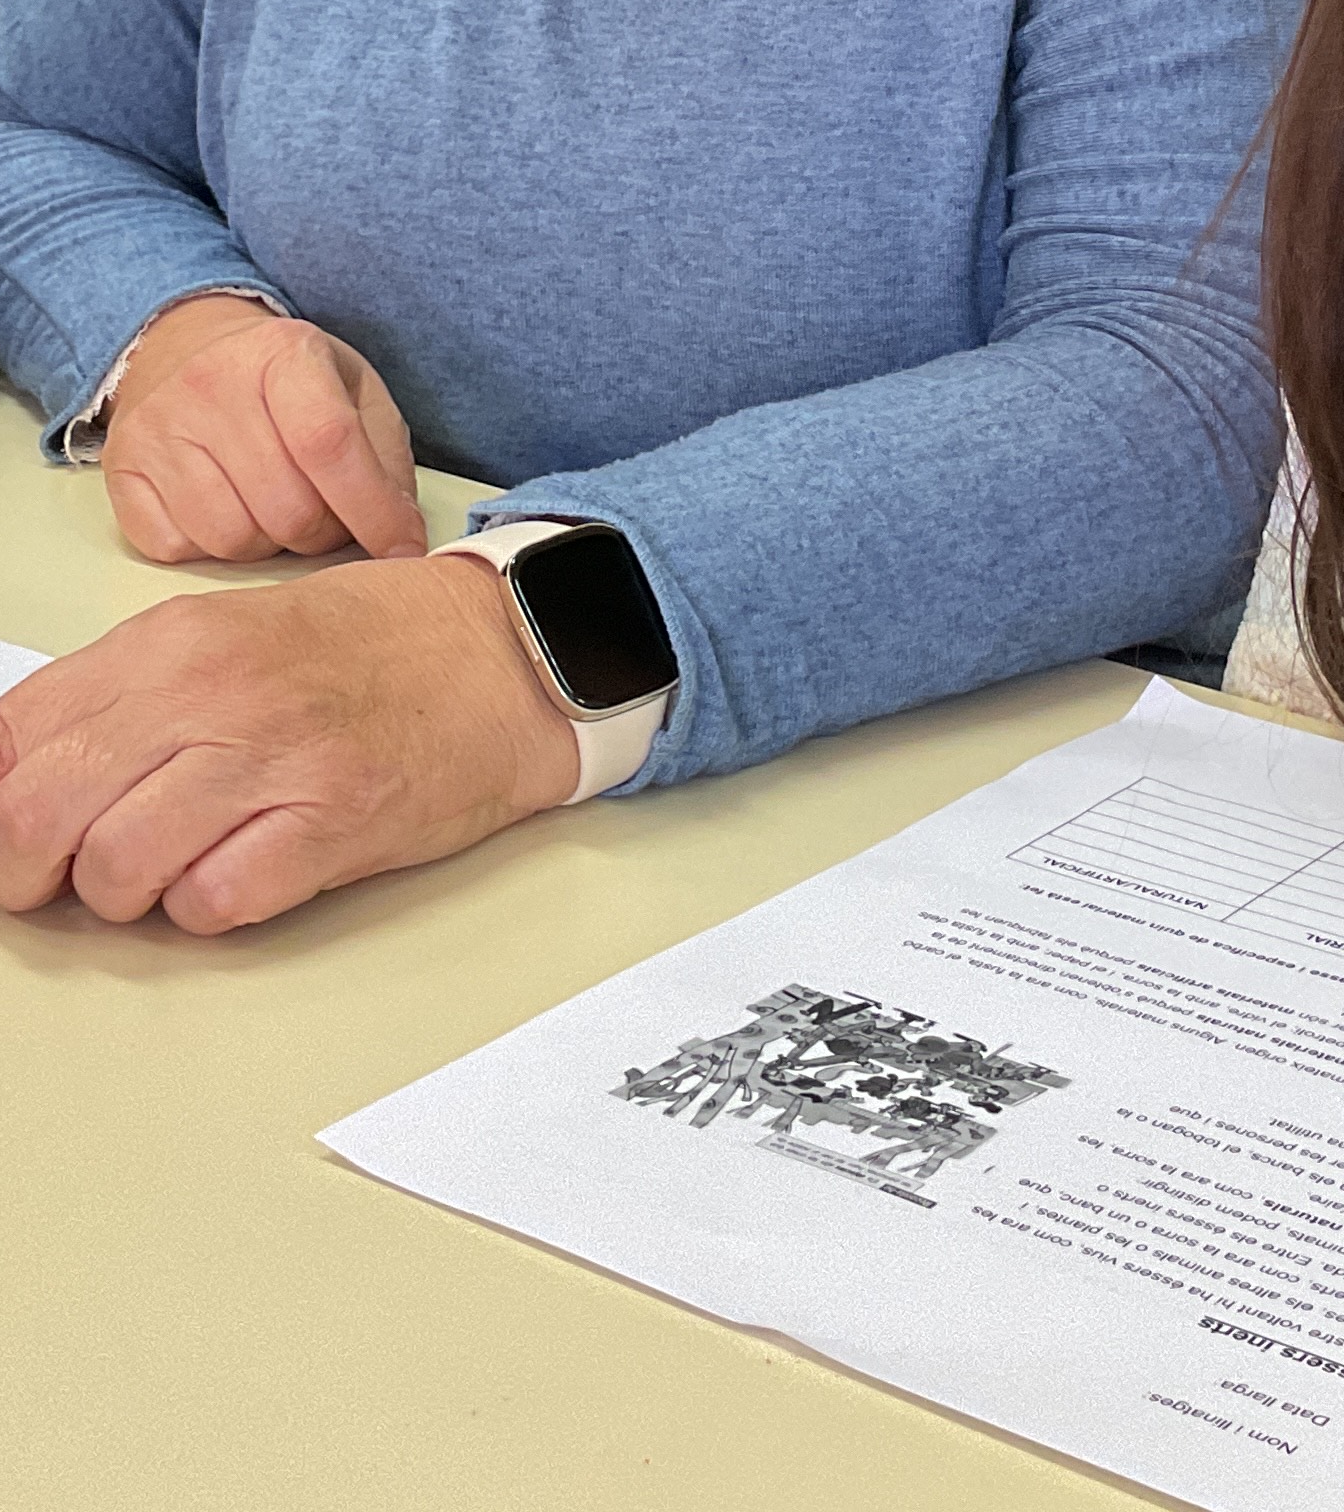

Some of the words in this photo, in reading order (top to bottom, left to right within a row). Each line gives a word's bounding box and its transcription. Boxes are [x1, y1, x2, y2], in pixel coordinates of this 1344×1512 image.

[1043, 856, 1208, 909] NATURAL/ARTIFICIAL
[1046, 892, 1080, 904] està
[1080, 902, 1147, 924] material
[1148, 922, 1185, 936] quin
[1188, 935, 1209, 943] de
[1212, 941, 1296, 968] especifica
[1116, 1107, 1134, 1118] la
[1168, 1105, 1202, 1119] que
[1150, 1119, 1221, 1148] tobogan
[1214, 1120, 1298, 1151] persones
[1077, 1135, 1104, 1149] les
[1220, 1144, 1241, 1153] el
[1298, 1148, 1327, 1163] les
[1159, 1164, 1178, 1175] la
[1180, 1171, 1211, 1184] ara
[1017, 1178, 1052, 1194] que
[1307, 1172, 1335, 1185] els
[1213, 1182, 1254, 1199] com
[1112, 1189, 1163, 1213] inerts
[971, 1205, 998, 1221] les
[1106, 1210, 1131, 1222] un
[1164, 1208, 1226, 1234] éssers
[1214, 1203, 1281, 1230] podem
[999, 1217, 1031, 1231] ara
[1032, 1229, 1072, 1247] com
[1103, 1232, 1133, 1247] les
[1150, 1226, 1199, 1246] sorra
[1229, 1231, 1258, 1244] els
[1202, 1244, 1221, 1256] la
[1260, 1243, 1312, 1266] Entre
[1151, 1249, 1225, 1279] animals
[1223, 1252, 1256, 1267] ara
[1121, 1262, 1184, 1289] éssers
[1258, 1265, 1301, 1282] com
[1187, 1286, 1214, 1301] ha
[1226, 1277, 1281, 1299] altres
[1212, 1297, 1236, 1309] hi
[1283, 1297, 1314, 1310] els
[1236, 1304, 1302, 1332] voltant
[1196, 1315, 1283, 1352] inerts
[1280, 1402, 1331, 1426] Data
[1247, 1429, 1298, 1454] Nom
